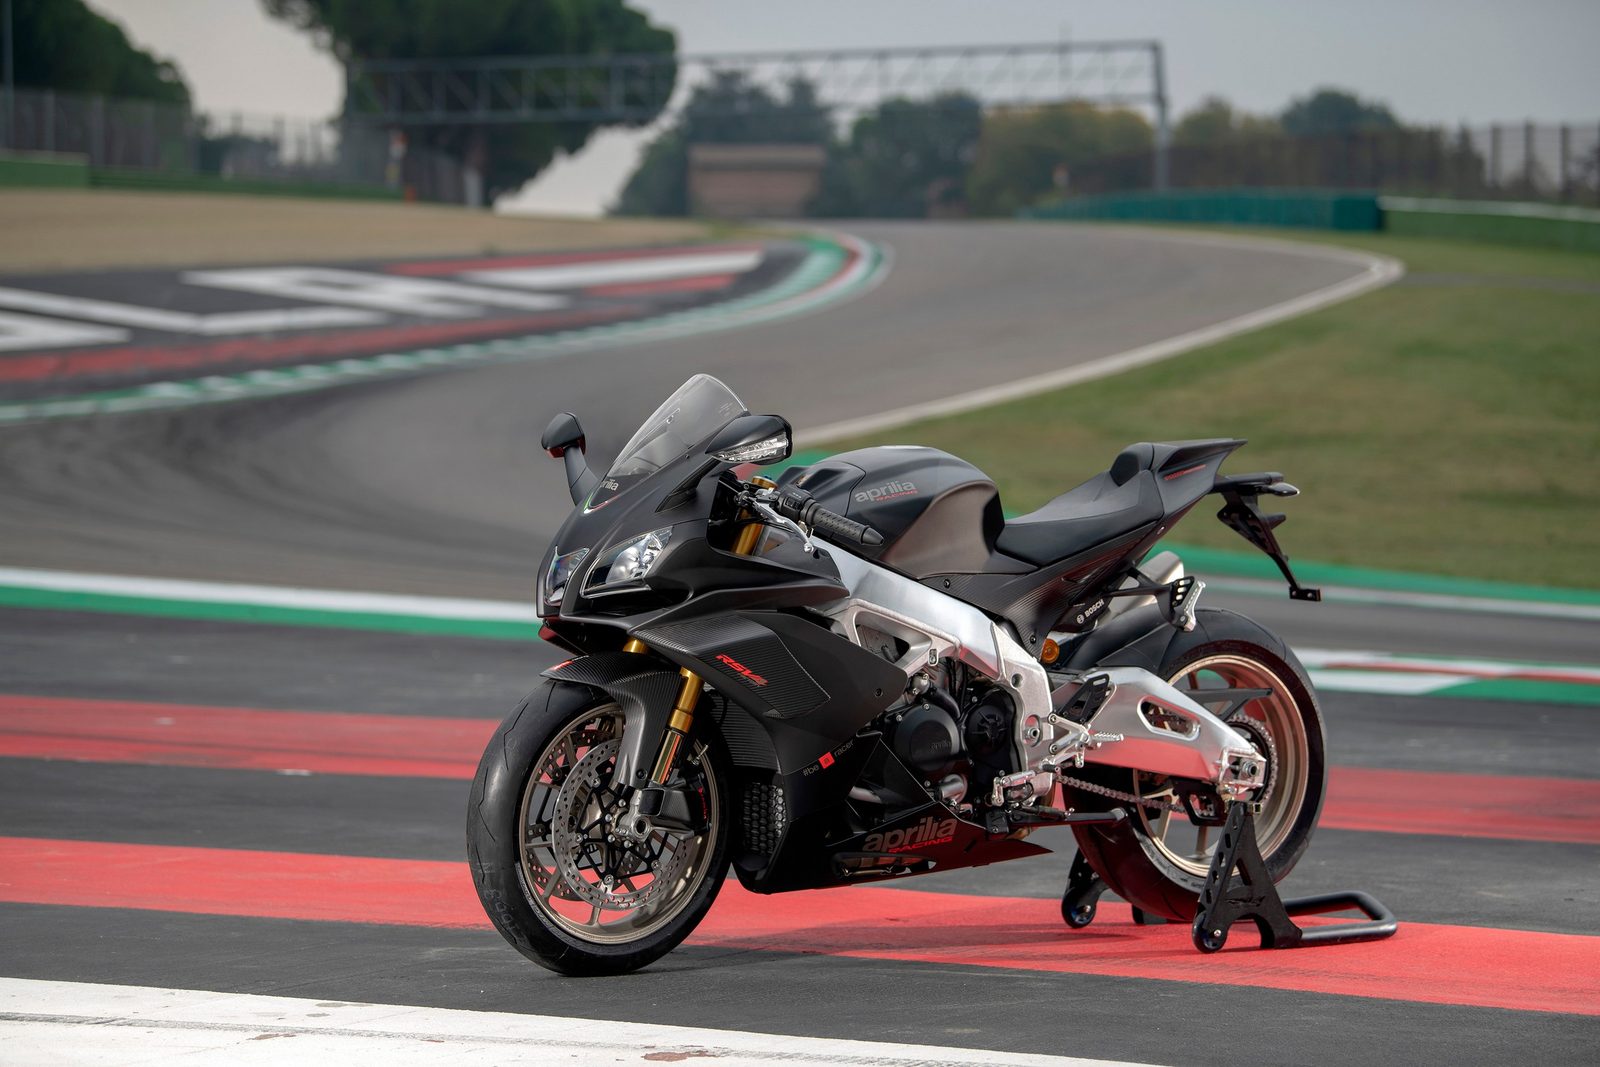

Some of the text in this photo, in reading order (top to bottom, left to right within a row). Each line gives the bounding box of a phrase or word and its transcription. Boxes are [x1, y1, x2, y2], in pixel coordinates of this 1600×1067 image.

[854, 480, 917, 502] aprilia
[1084, 599, 1105, 618] BOSCH
[834, 739, 854, 757] racer
[862, 815, 958, 853] aprilia
[888, 836, 954, 853] RACING
